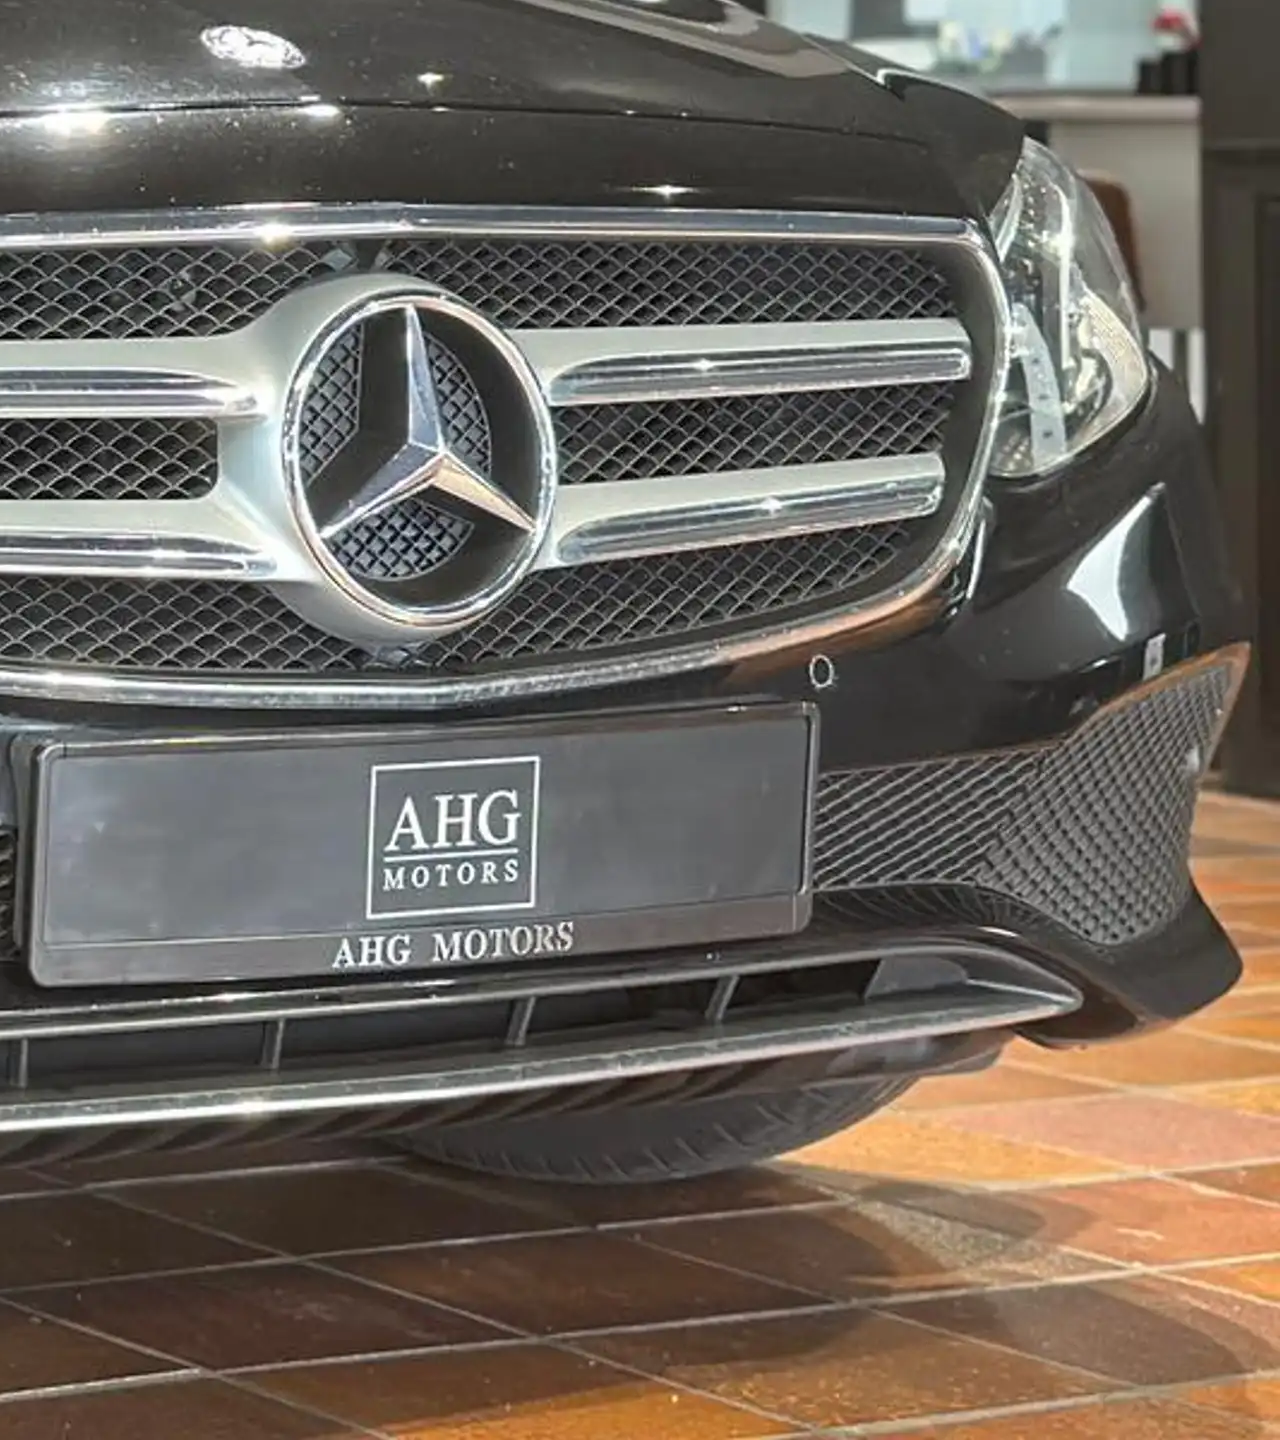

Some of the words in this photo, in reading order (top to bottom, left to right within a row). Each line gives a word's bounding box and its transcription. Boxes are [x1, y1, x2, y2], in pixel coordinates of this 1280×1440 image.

[383, 789, 522, 852] AHG
[382, 859, 519, 892] MOTORS
[332, 934, 412, 968] AHG
[432, 921, 574, 963] MOTORS
